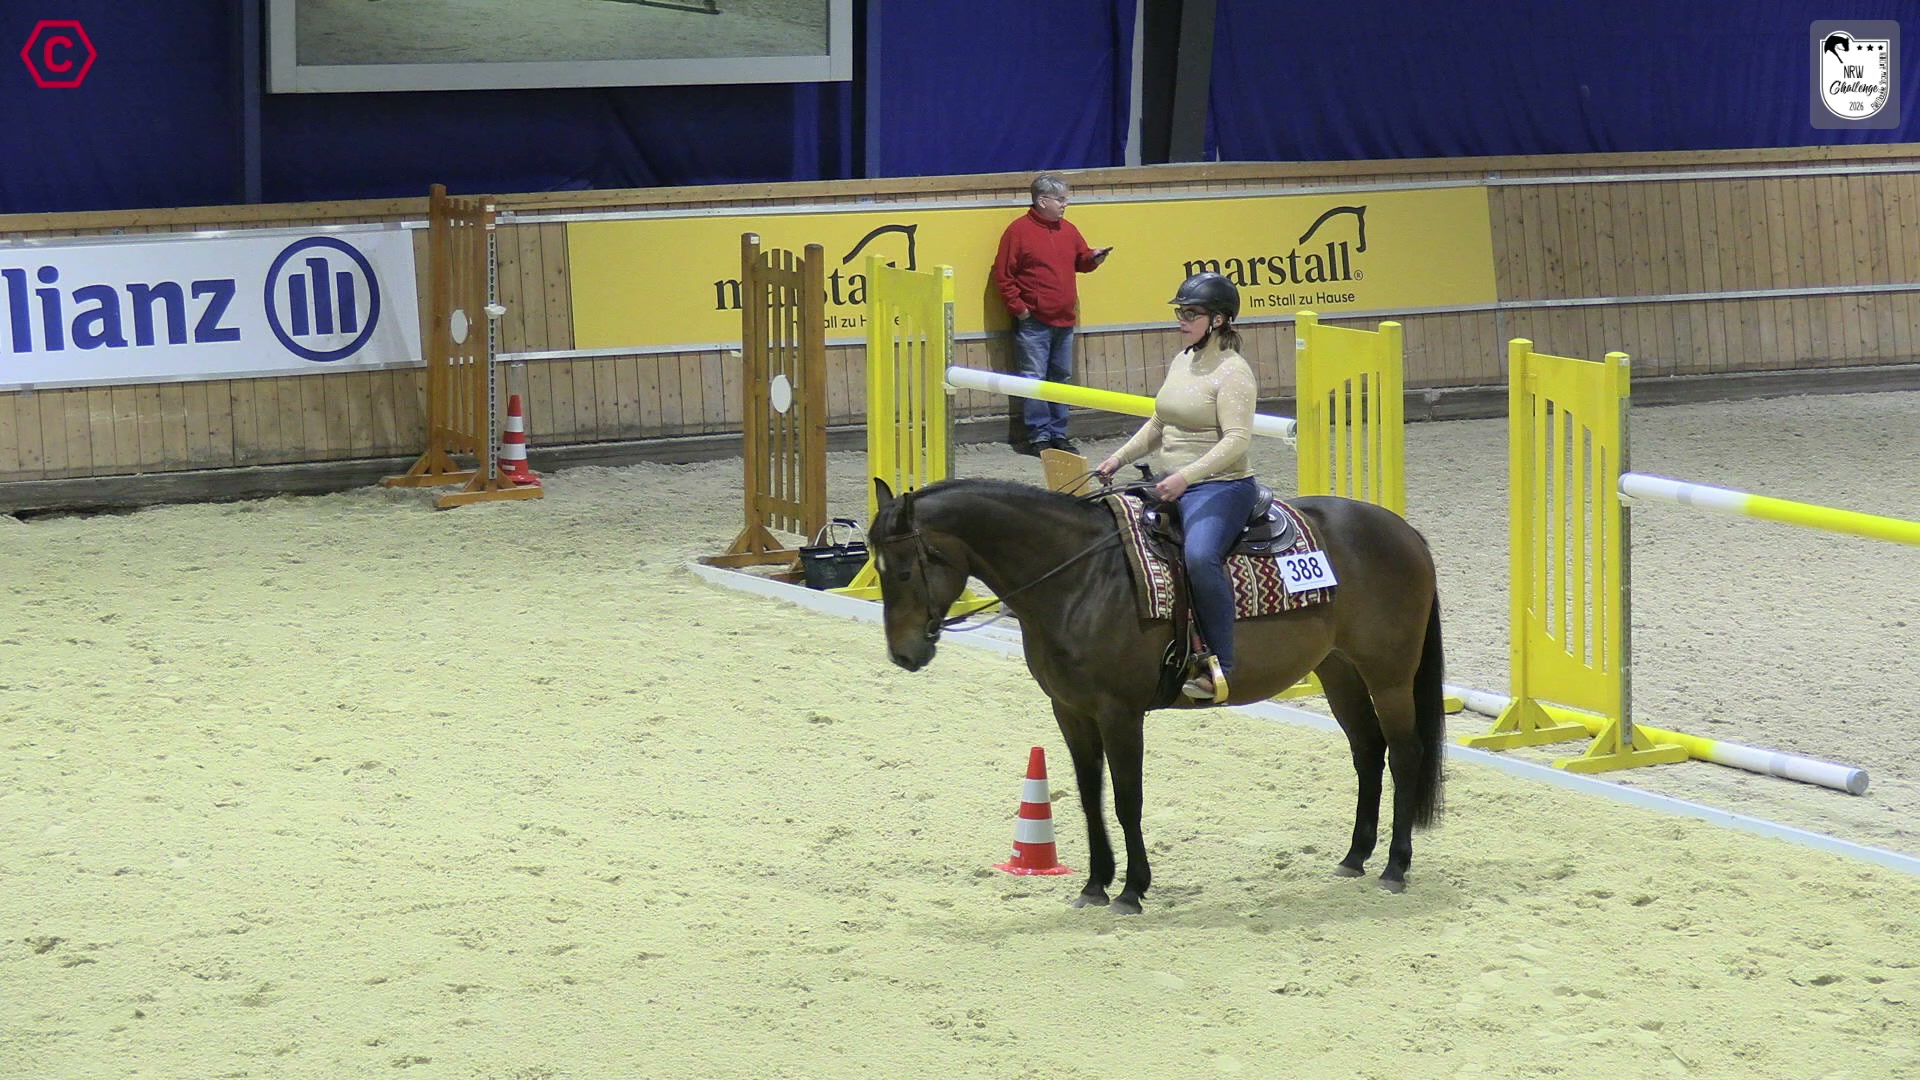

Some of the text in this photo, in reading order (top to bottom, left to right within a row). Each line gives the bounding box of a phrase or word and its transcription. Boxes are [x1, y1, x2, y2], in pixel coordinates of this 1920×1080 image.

[1250, 292, 1355, 308] Im Stall zu Hause
[841, 318, 856, 328] zu
[1286, 557, 1323, 582] 388
